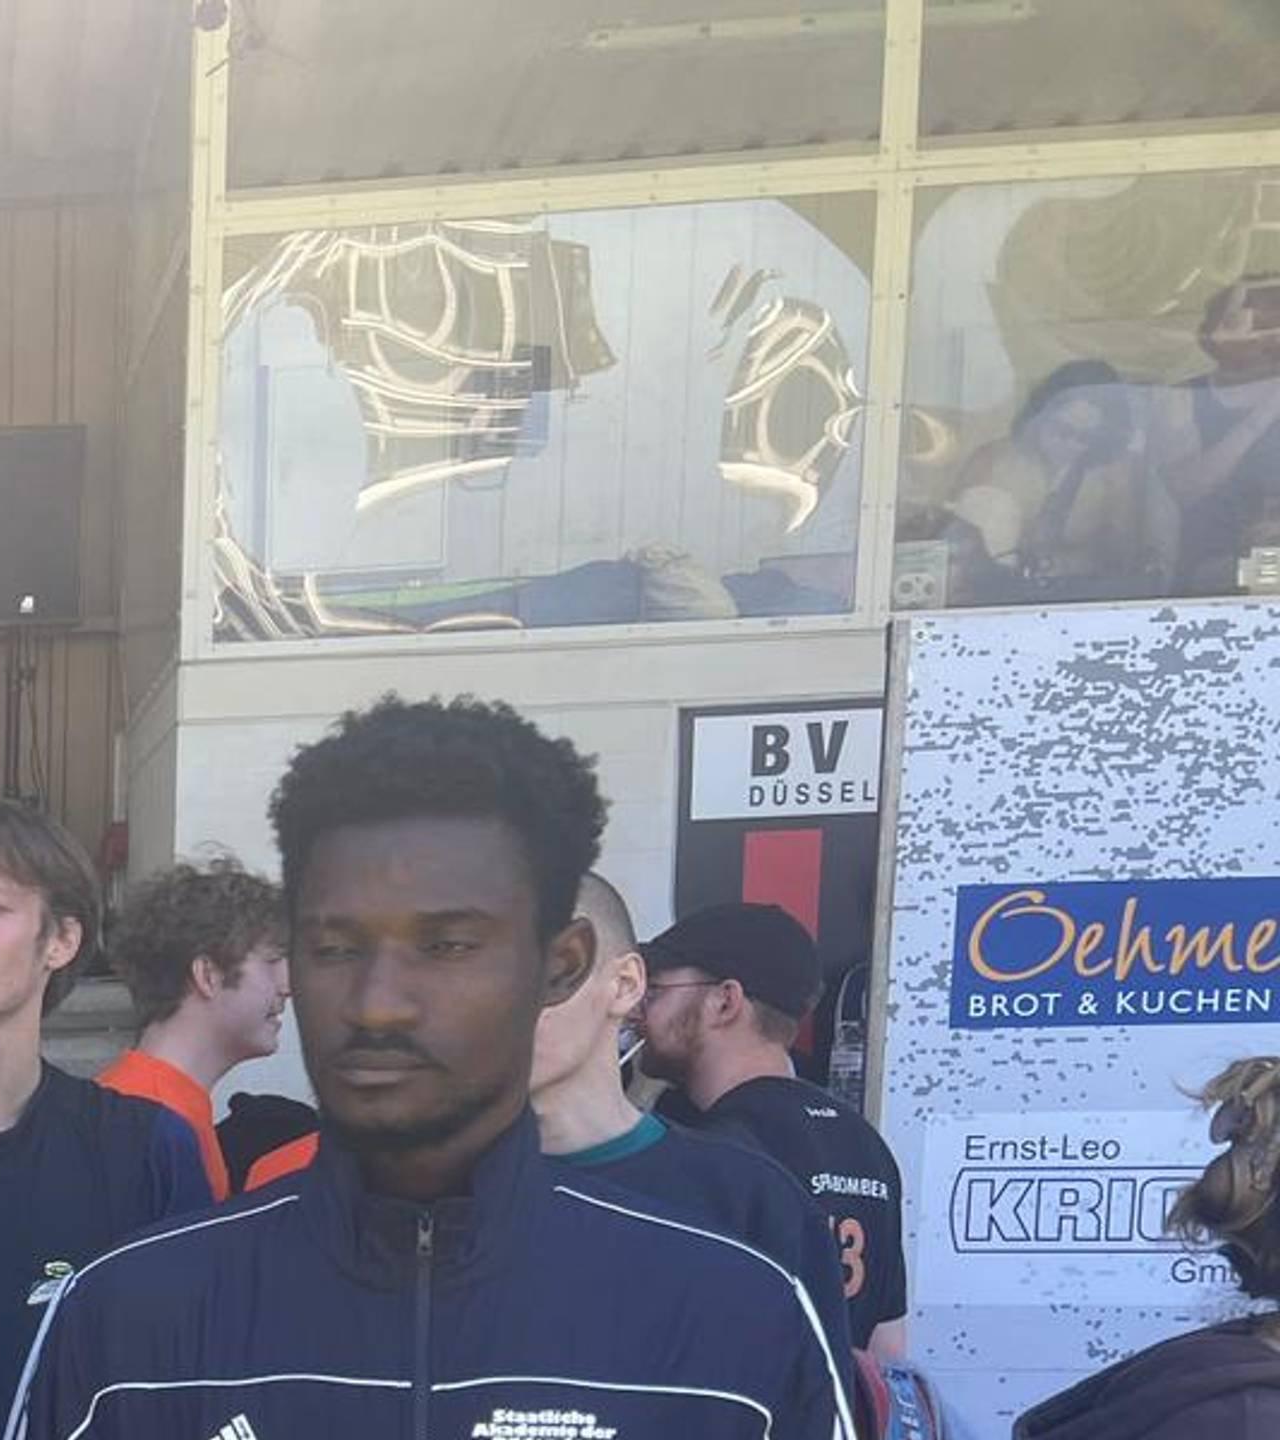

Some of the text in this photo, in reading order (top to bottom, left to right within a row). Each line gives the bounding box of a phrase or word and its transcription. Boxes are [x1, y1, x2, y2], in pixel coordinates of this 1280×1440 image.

[749, 779, 876, 807] DÜSSEL
[968, 889, 1280, 982] Oehme
[968, 988, 1271, 1017] BROT & KUCHEN
[965, 1134, 1121, 1160] Ernst-Leo
[492, 1408, 597, 1425] Staatliche
[579, 1425, 617, 1440] der
